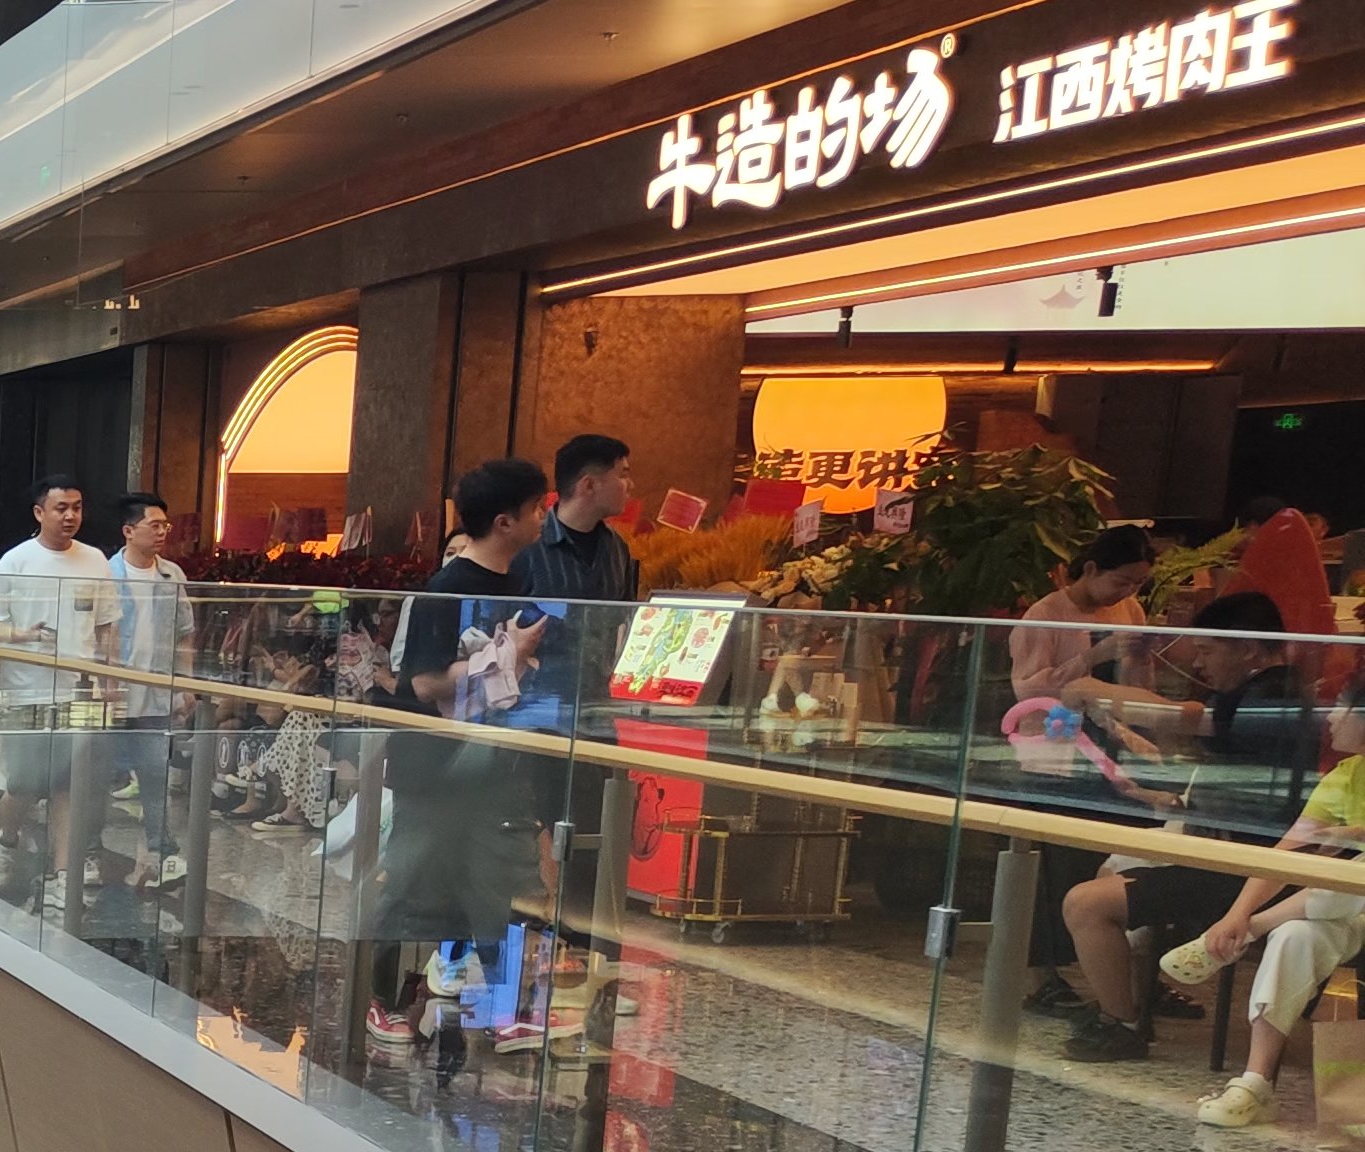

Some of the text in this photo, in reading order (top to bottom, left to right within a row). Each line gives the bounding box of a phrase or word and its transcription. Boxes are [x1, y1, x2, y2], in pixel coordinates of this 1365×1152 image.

[646, 46, 955, 229] 牛造的场
[993, 0, 1301, 144] 江西烤肉王
